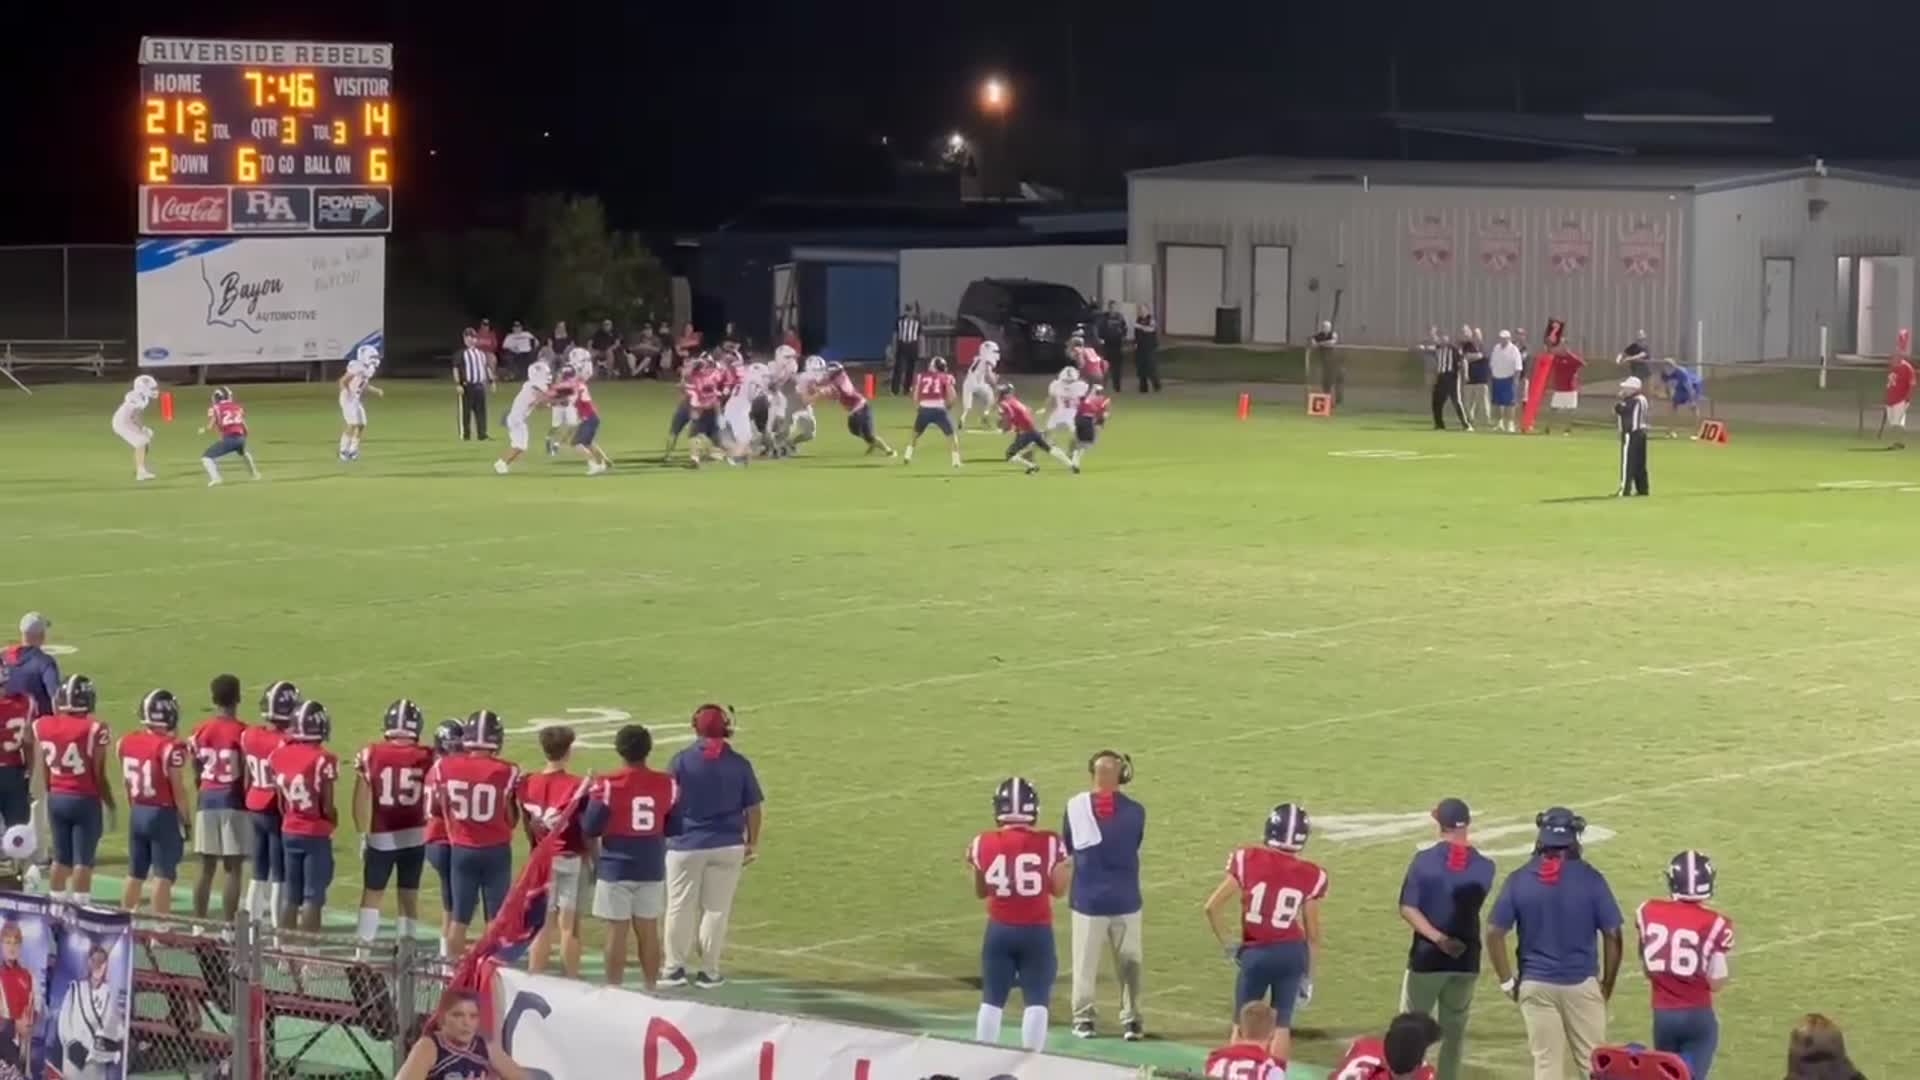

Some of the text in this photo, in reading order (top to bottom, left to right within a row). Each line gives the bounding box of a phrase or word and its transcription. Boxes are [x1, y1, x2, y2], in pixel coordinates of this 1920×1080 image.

[152, 41, 385, 65] RIVERSIDE REBELS
[154, 74, 203, 93] HOME
[245, 72, 315, 108] 7:46
[334, 77, 388, 96] VISITOR
[146, 99, 184, 134] 21
[251, 118, 277, 137] QTR
[365, 102, 389, 136] 14
[193, 120, 207, 143] 2
[212, 123, 230, 139] TOL
[281, 116, 296, 144] 3
[313, 124, 331, 140] TOL
[333, 121, 346, 144] 3
[149, 147, 168, 182] 2
[171, 154, 208, 174] DOWN
[238, 148, 256, 182] 6
[260, 154, 294, 174] TO GO
[304, 155, 351, 174] BALL ON
[370, 148, 387, 182] 6
[246, 190, 296, 220] RA
[256, 310, 317, 322] AUTOMOTIVE
[922, 378, 942, 394] 71
[1312, 396, 1326, 413] G
[1701, 423, 1719, 441] 10
[40, 741, 86, 776] 24
[172, 751, 183, 765] 5
[200, 747, 236, 783] 23
[123, 757, 157, 798] 51
[323, 763, 334, 779] 4
[379, 766, 423, 806] 15
[448, 779, 497, 822] 50
[632, 796, 655, 831] 6
[985, 853, 1042, 896] 46
[1245, 881, 1304, 929] 18
[1644, 922, 1699, 976] 26
[1721, 928, 1735, 947] 2
